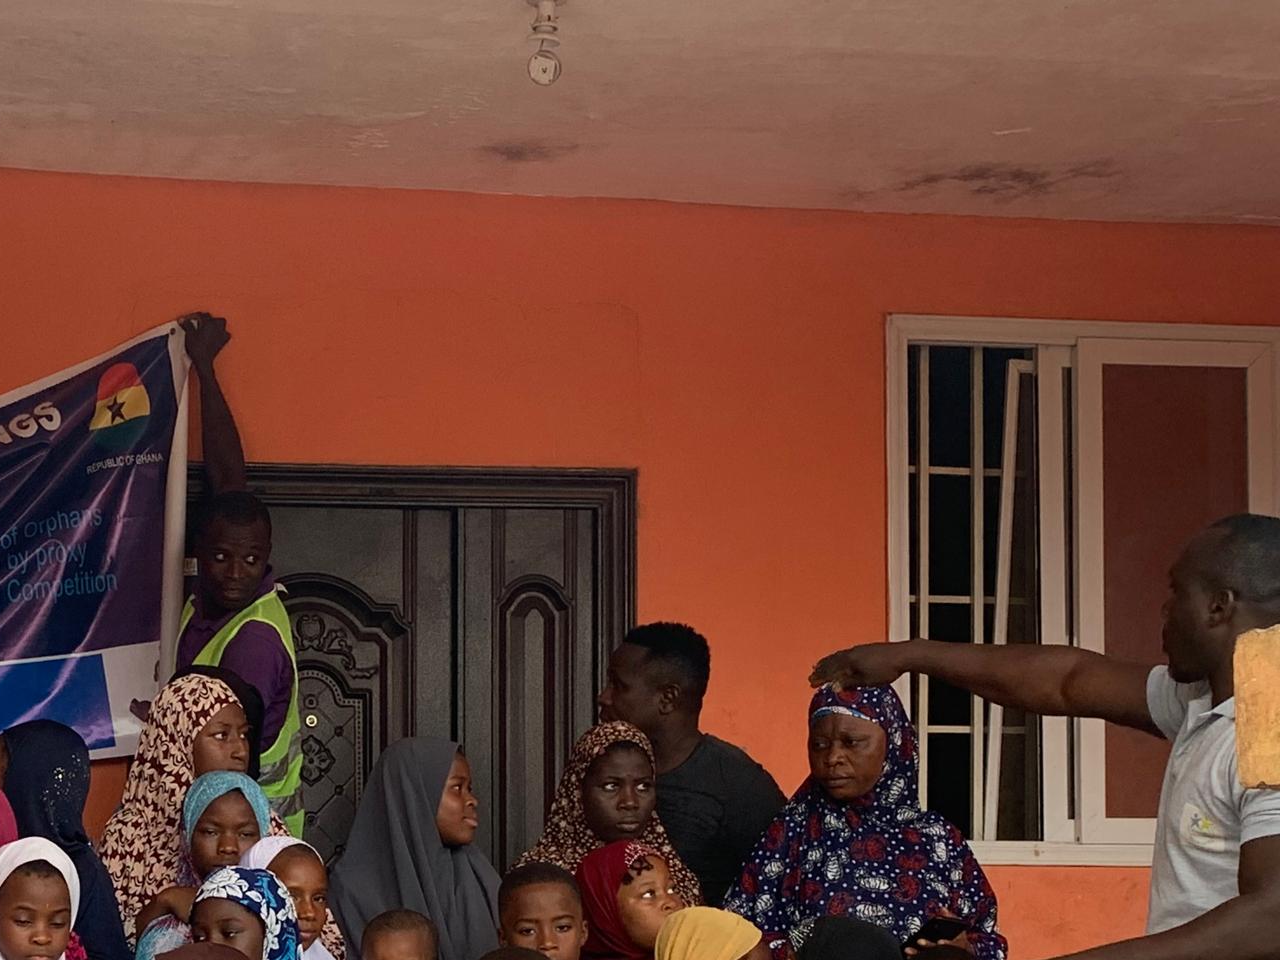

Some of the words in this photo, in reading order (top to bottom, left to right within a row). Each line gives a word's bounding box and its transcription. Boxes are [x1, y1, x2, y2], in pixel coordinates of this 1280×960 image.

[86, 456, 125, 475] REPUBLIC
[125, 454, 135, 466] OF
[136, 452, 164, 466] GHANA
[0, 530, 18, 551] of
[24, 506, 103, 539] Orphans
[7, 553, 28, 575] by
[36, 542, 88, 571] proxy
[7, 572, 119, 604] Competition
